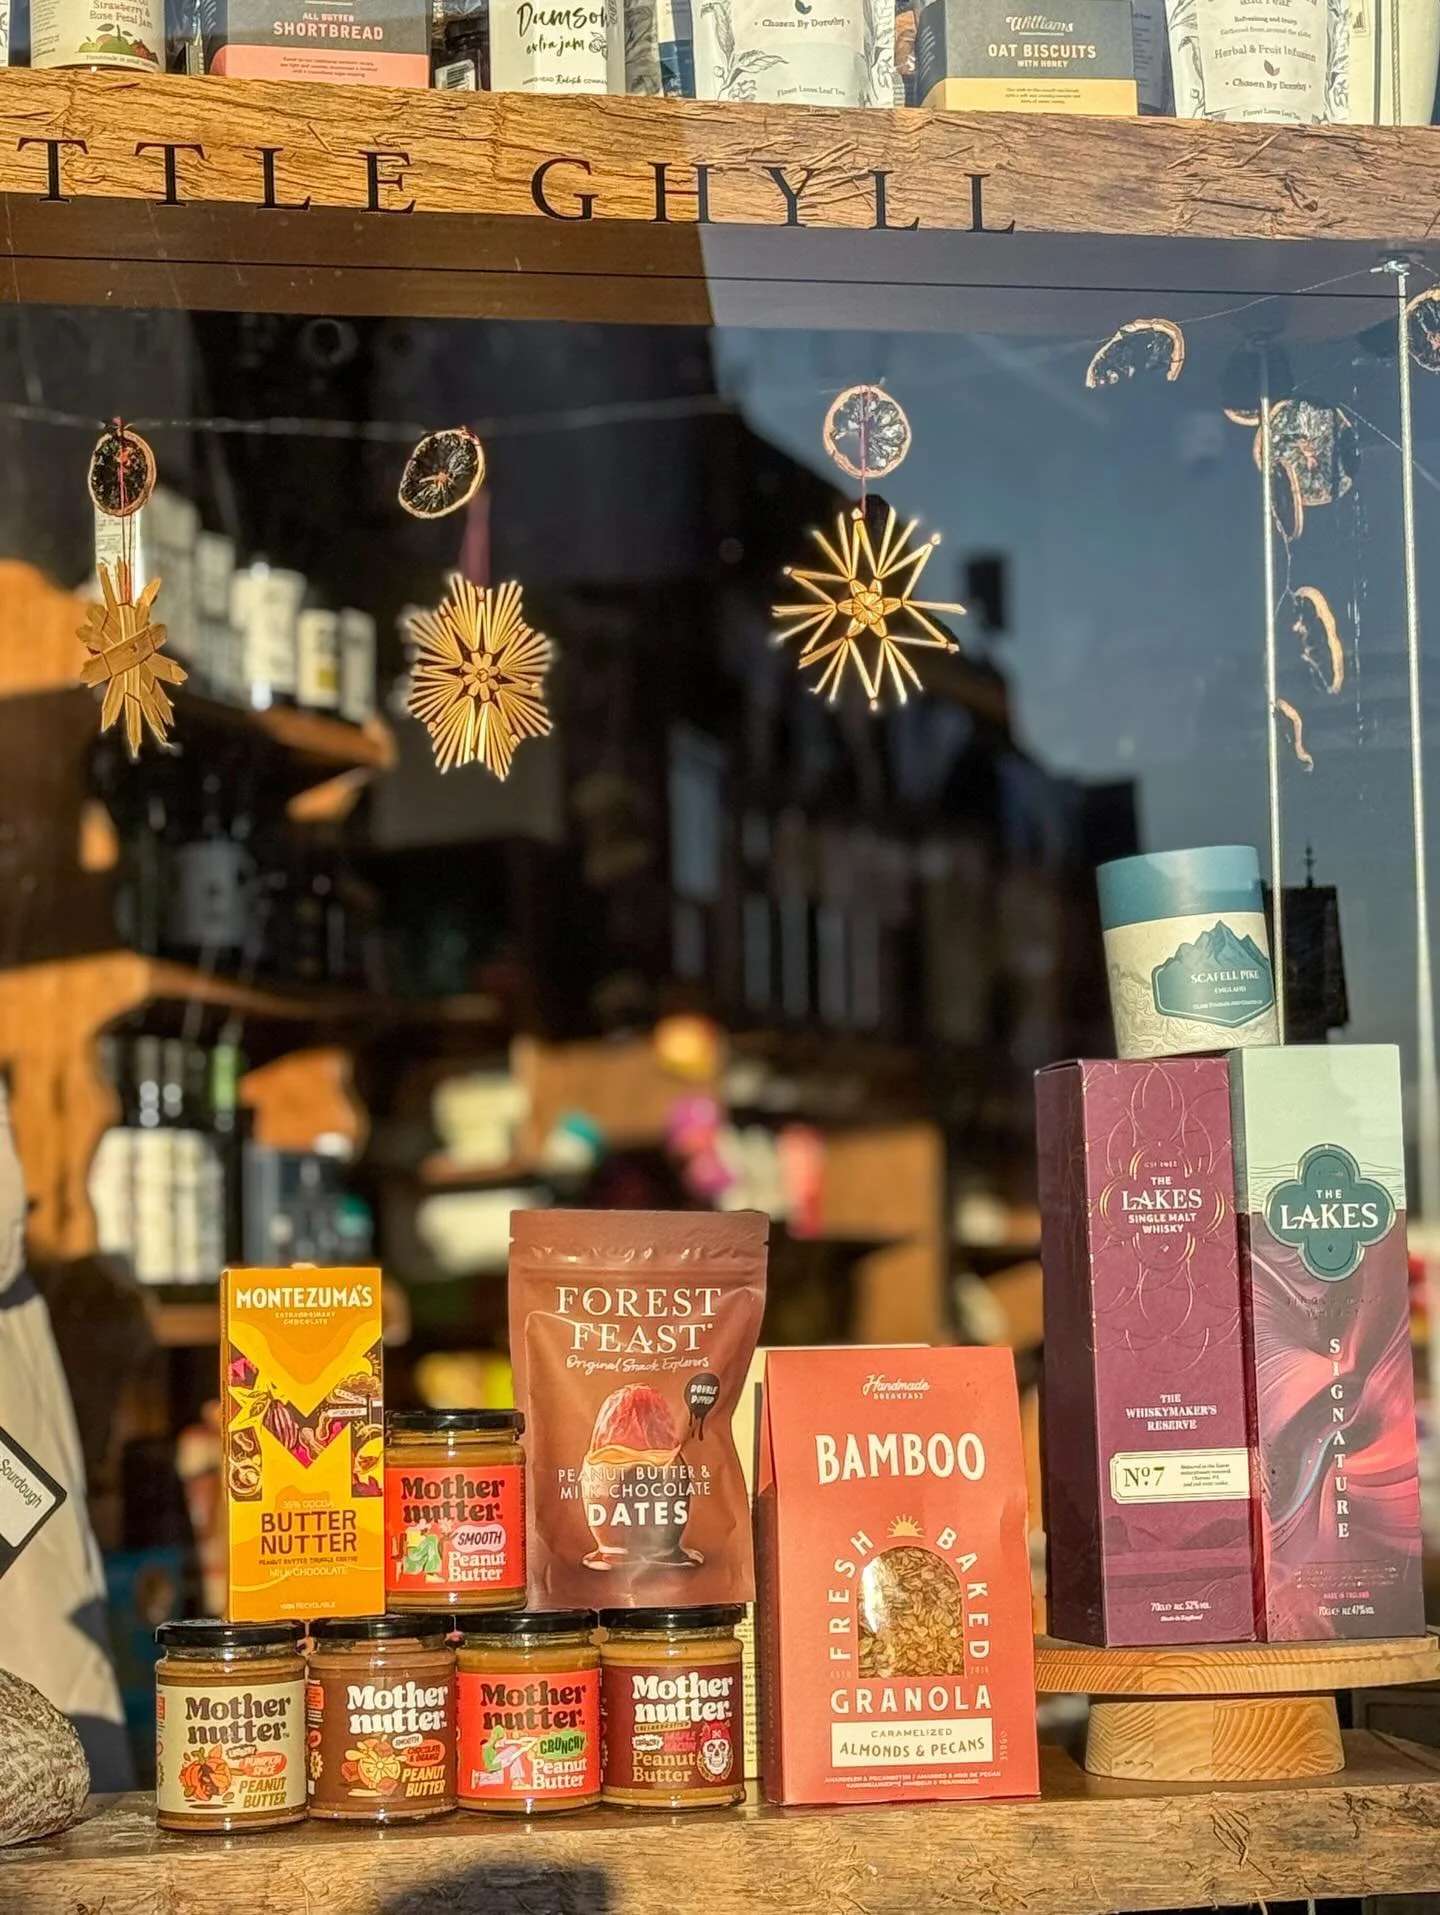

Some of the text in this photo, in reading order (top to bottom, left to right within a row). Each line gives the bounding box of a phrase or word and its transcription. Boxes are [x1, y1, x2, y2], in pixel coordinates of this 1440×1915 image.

[302, 12, 354, 22] ALL BUTTER
[762, 17, 845, 29] Chosen By Dorothy
[1005, 15, 1075, 33] Williams
[273, 21, 383, 41] SHORTBREAD
[988, 43, 1097, 59] OAT BISCUITS
[1214, 45, 1247, 59] Herbal
[1249, 45, 1256, 54] &
[1258, 44, 1282, 55] Fruit
[1017, 60, 1069, 68] WITH HONEY
[1232, 78, 1265, 89] Chosen
[1266, 79, 1277, 90] By
[530, 157, 1015, 234] GHYLL
[1191, 969, 1259, 984] SCAFELL PIKE
[1150, 1176, 1172, 1186] THE
[1121, 1188, 1203, 1211] LAKES
[1316, 1189, 1342, 1199] THE
[1128, 1212, 1197, 1224] SINGLE MALT
[1280, 1202, 1379, 1230] LAKES
[1142, 1224, 1184, 1234] WHISKY
[236, 1284, 372, 1309] MONTEZUMA'S
[555, 1286, 721, 1318] FOREST
[570, 1323, 708, 1353] FEAST
[566, 1354, 620, 1375] Original
[622, 1358, 660, 1372] Snack
[862, 1374, 930, 1396] Handmade
[1160, 1394, 1181, 1403] THE
[1125, 1405, 1217, 1419] WHISKYMAKER'S
[1147, 1419, 1197, 1431] RESERVE
[1329, 1337, 1350, 1539] SIGNATURE
[815, 1432, 986, 1485] BAMBOO
[558, 1464, 711, 1483] PEANUT BUTTER &
[1, 1458, 42, 1509] Sourdough
[401, 1474, 505, 1500] Mother
[560, 1481, 711, 1500] MILK CHOCOLATE
[261, 1509, 357, 1533] BUTTER
[587, 1502, 688, 1527] DATES
[261, 1532, 357, 1555] NUTTER
[457, 1531, 502, 1546] SMOOTH
[448, 1551, 506, 1567] Peanut
[292, 1566, 347, 1577] CHOCOLATE
[448, 1567, 503, 1583] Butter
[828, 1530, 874, 1660] FRESH
[936, 1527, 990, 1659] BAKED
[480, 1680, 586, 1707] Mother
[632, 1671, 733, 1699] Mother
[347, 1681, 449, 1710] Mother
[830, 1684, 992, 1714] GRANOLA
[185, 1693, 291, 1720] Mother
[871, 1728, 953, 1738] CARAMELIZED
[540, 1734, 585, 1755] CRUNCHY
[840, 1737, 985, 1758] ALMONDS & PECANS
[532, 1758, 587, 1775] Peanut
[632, 1751, 696, 1766] Peanut
[401, 1765, 446, 1783] PEANUT
[532, 1774, 585, 1790] Butter
[632, 1766, 692, 1782] Butter
[238, 1776, 287, 1794] PEANUT
[405, 1780, 446, 1798] BUTTER
[243, 1792, 287, 1809] BUTTER
